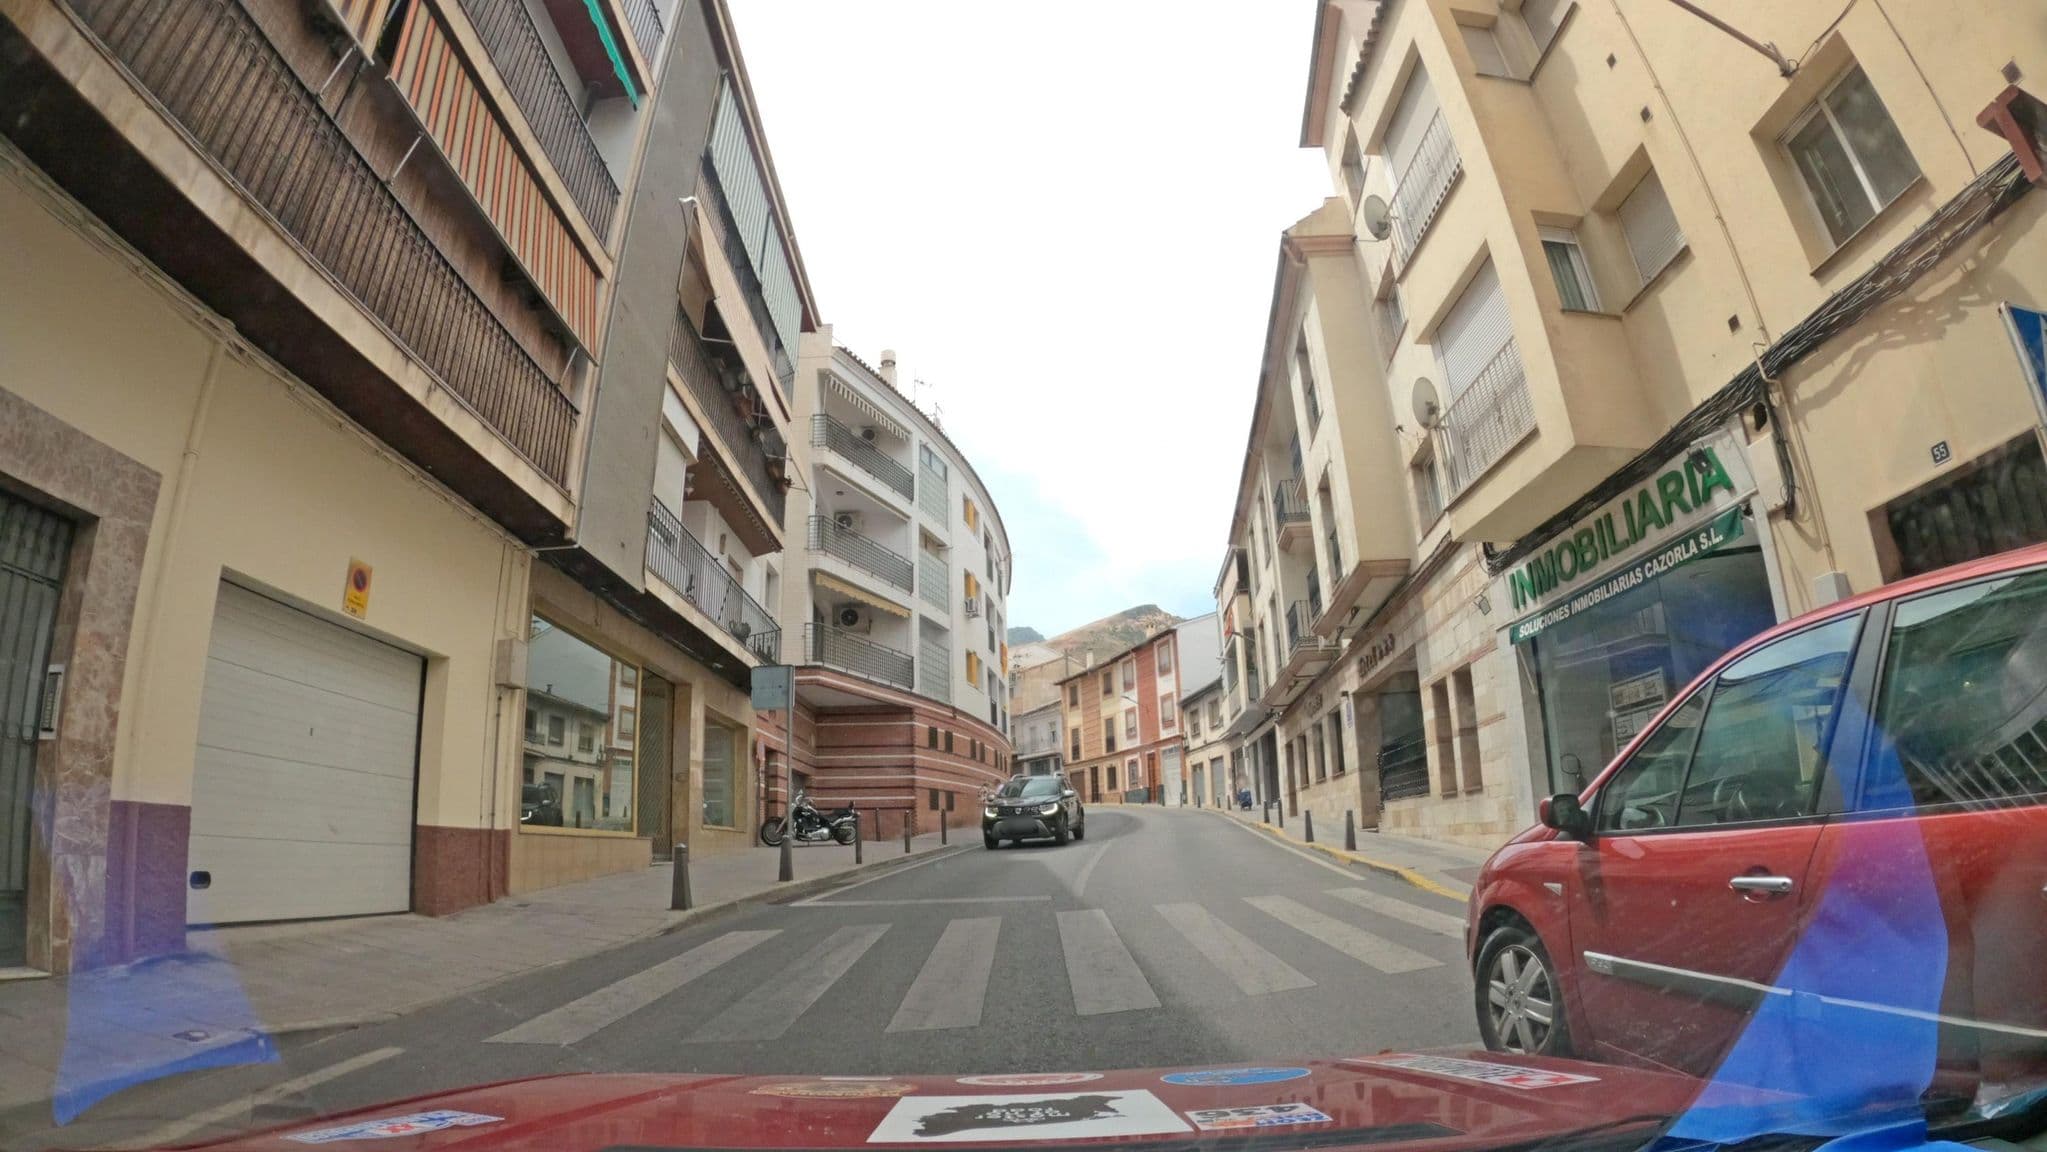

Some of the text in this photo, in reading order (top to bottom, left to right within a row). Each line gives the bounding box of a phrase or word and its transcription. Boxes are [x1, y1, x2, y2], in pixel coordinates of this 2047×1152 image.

[1933, 443, 1947, 460] 55
[1509, 446, 1735, 610] INMOBILIARIA
[1519, 527, 1724, 637] SOLUCIONES INMOBILIARIAS CAZORLA S.L.
